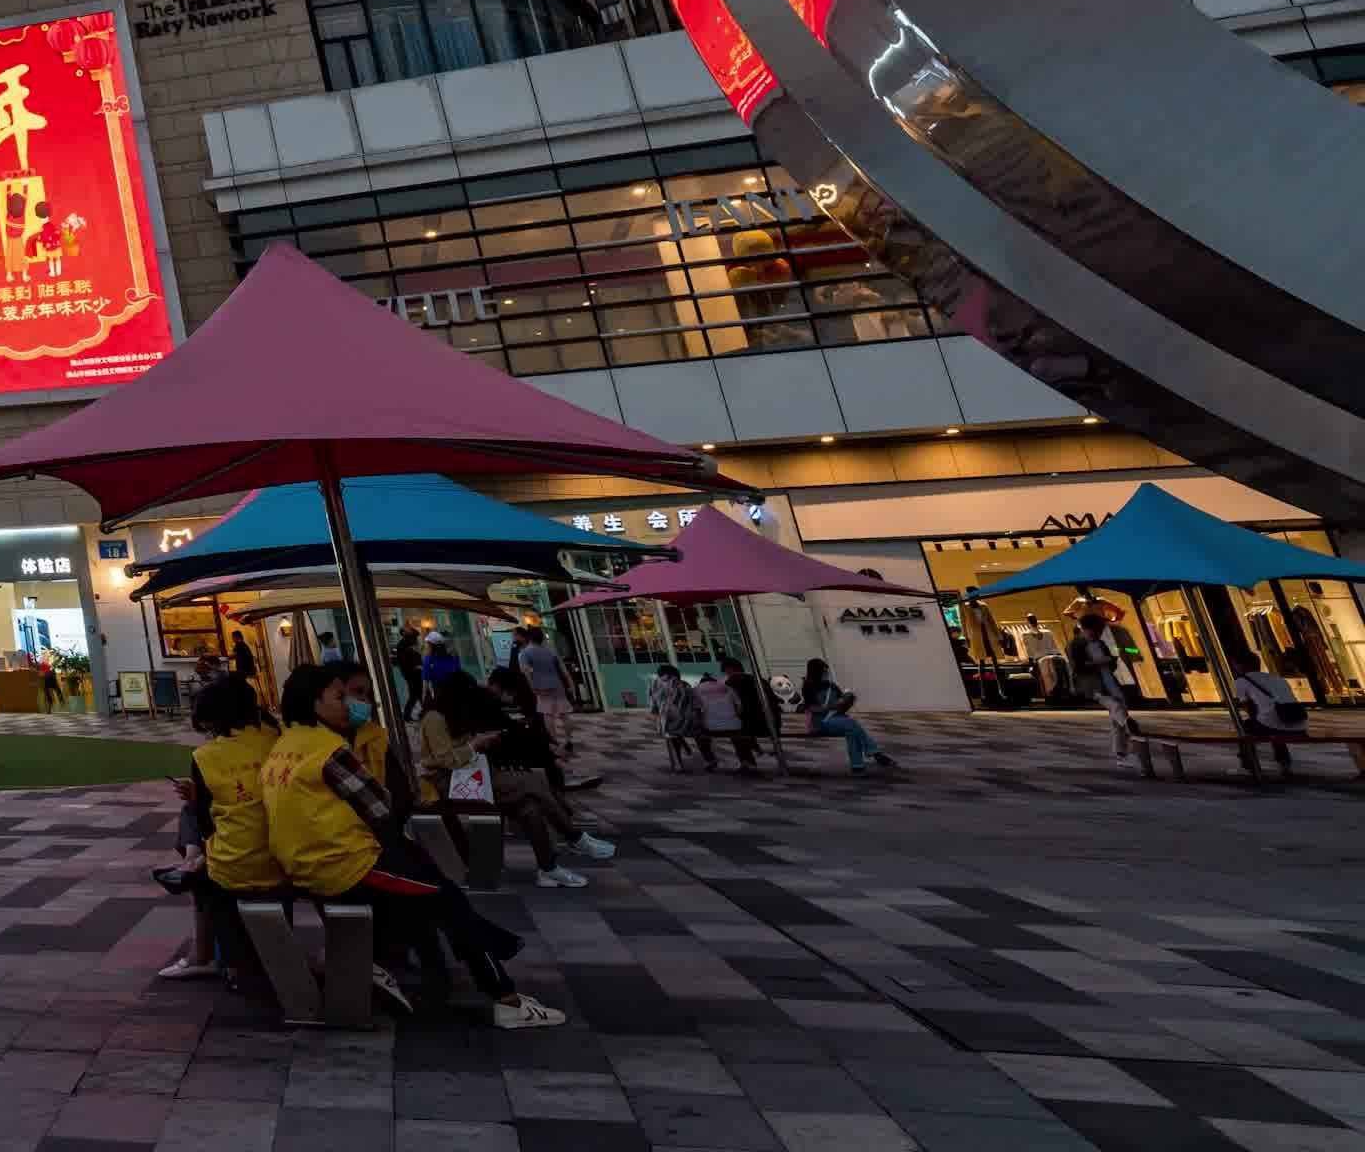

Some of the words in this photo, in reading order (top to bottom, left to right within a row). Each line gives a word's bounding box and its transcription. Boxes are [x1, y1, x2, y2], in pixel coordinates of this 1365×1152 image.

[37, 279, 94, 299] 贴春联
[21, 556, 72, 575] 体验店
[842, 606, 924, 618] AMASS
